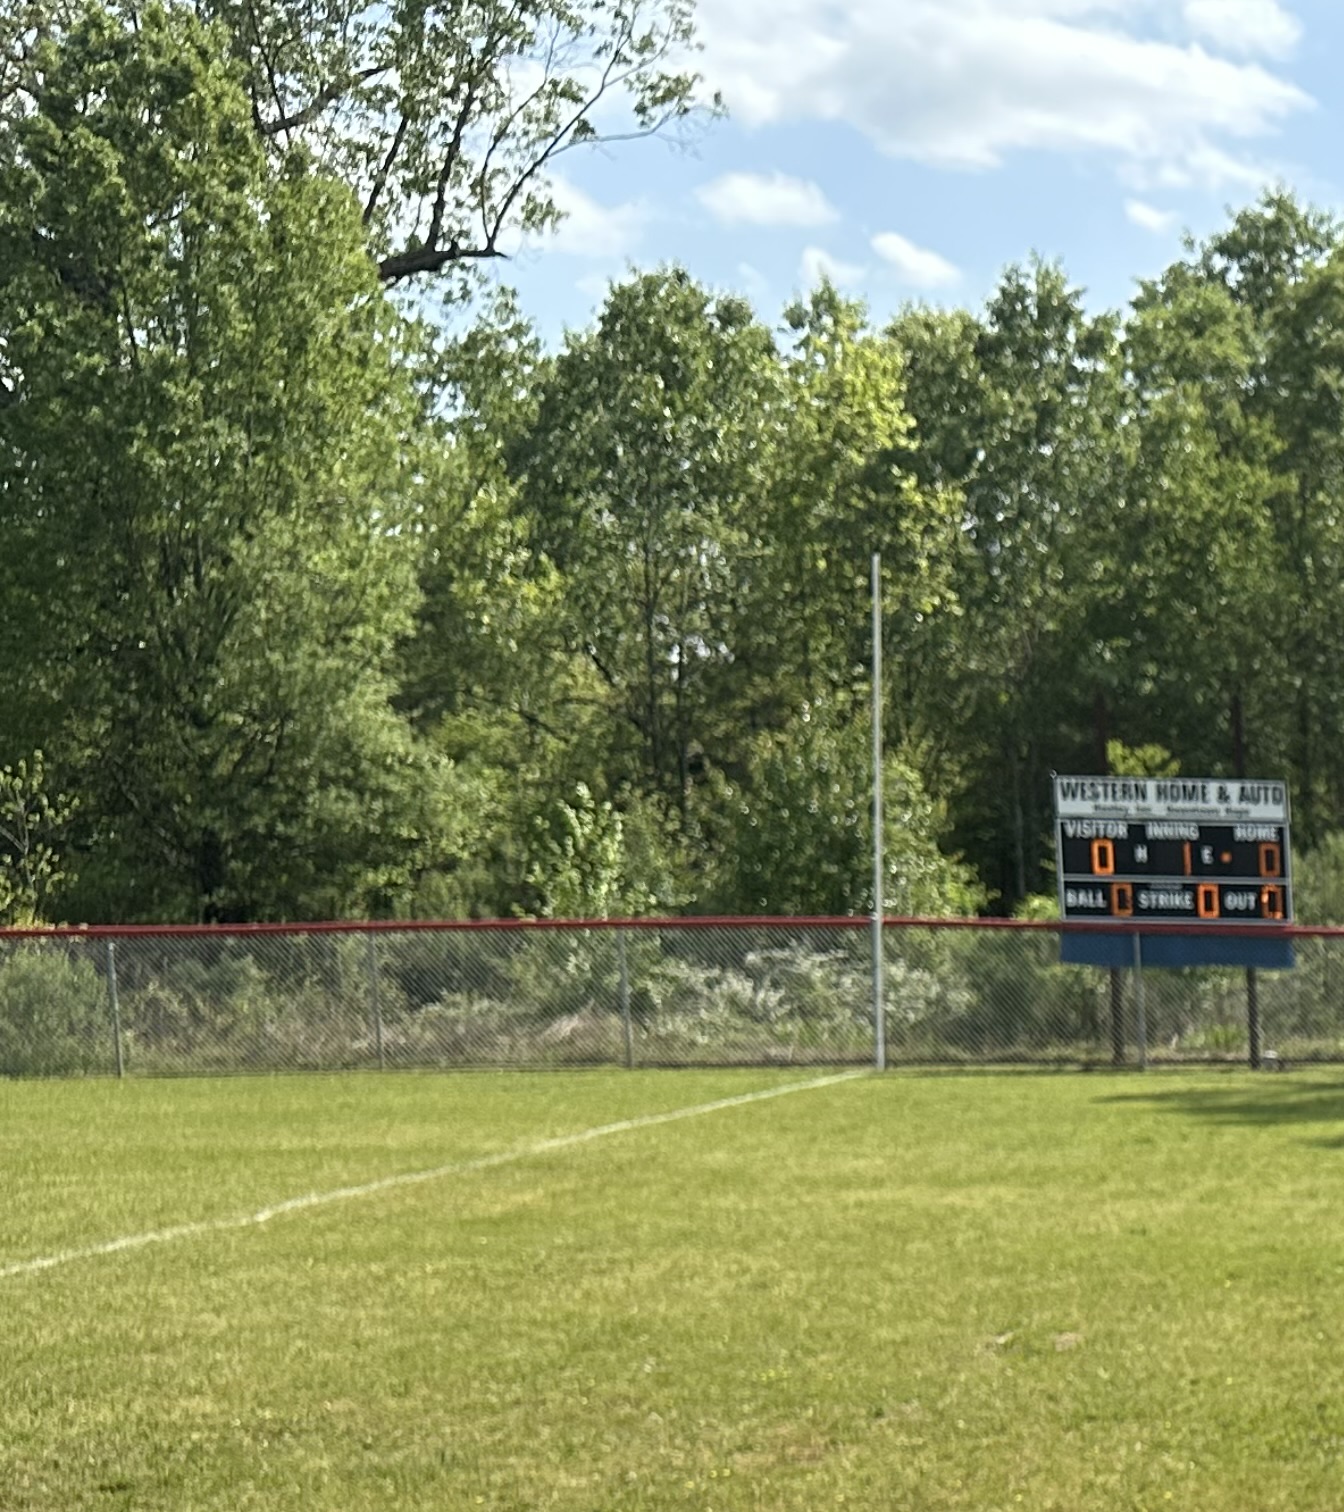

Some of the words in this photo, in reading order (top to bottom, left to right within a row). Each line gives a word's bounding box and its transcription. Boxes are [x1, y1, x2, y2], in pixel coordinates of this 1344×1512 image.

[1060, 782, 1147, 801] WESTERN
[1157, 783, 1209, 804] HOME
[1218, 785, 1231, 803] &
[1239, 786, 1282, 806] AUTO
[1064, 820, 1128, 839] VISITOR
[1146, 822, 1199, 841] INNING
[1233, 825, 1279, 842] HOME
[1091, 838, 1115, 876] 0
[1134, 844, 1148, 863] H
[1201, 845, 1214, 864] E
[1259, 842, 1281, 877] 0
[1066, 888, 1107, 908] BALL
[1138, 889, 1195, 910] STRIKE
[1198, 883, 1220, 918] 0
[1224, 890, 1257, 910] OUT
